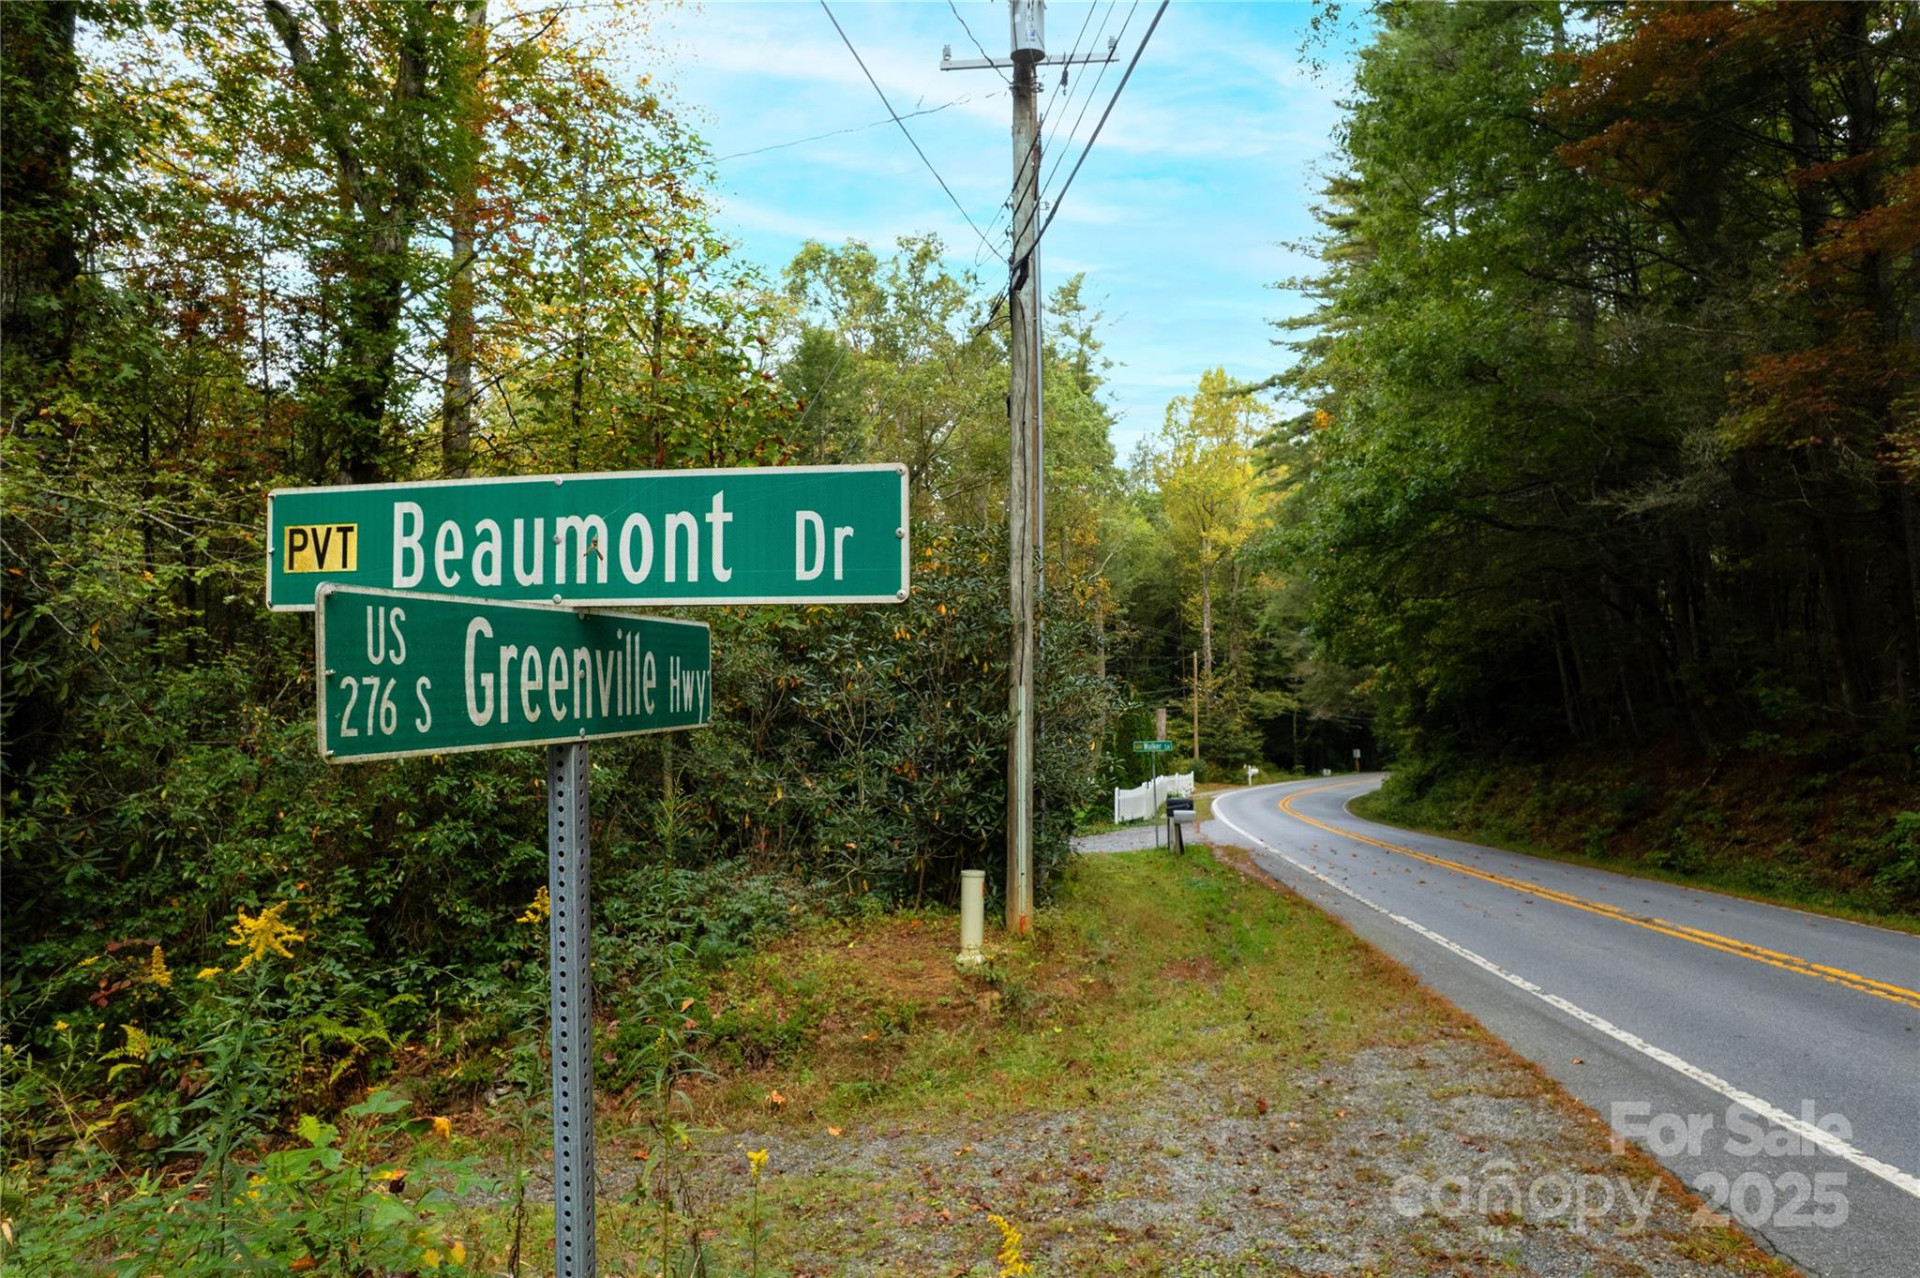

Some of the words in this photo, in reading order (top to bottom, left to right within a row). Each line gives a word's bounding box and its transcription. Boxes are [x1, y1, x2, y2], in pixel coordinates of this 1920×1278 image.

[288, 526, 354, 570] PVT
[392, 489, 733, 588] Beaumont
[795, 510, 854, 581] Dr
[366, 605, 406, 665] US
[464, 616, 657, 727] Greenville
[669, 655, 706, 724] Hwy
[340, 675, 397, 737] 276
[415, 675, 432, 733] S
